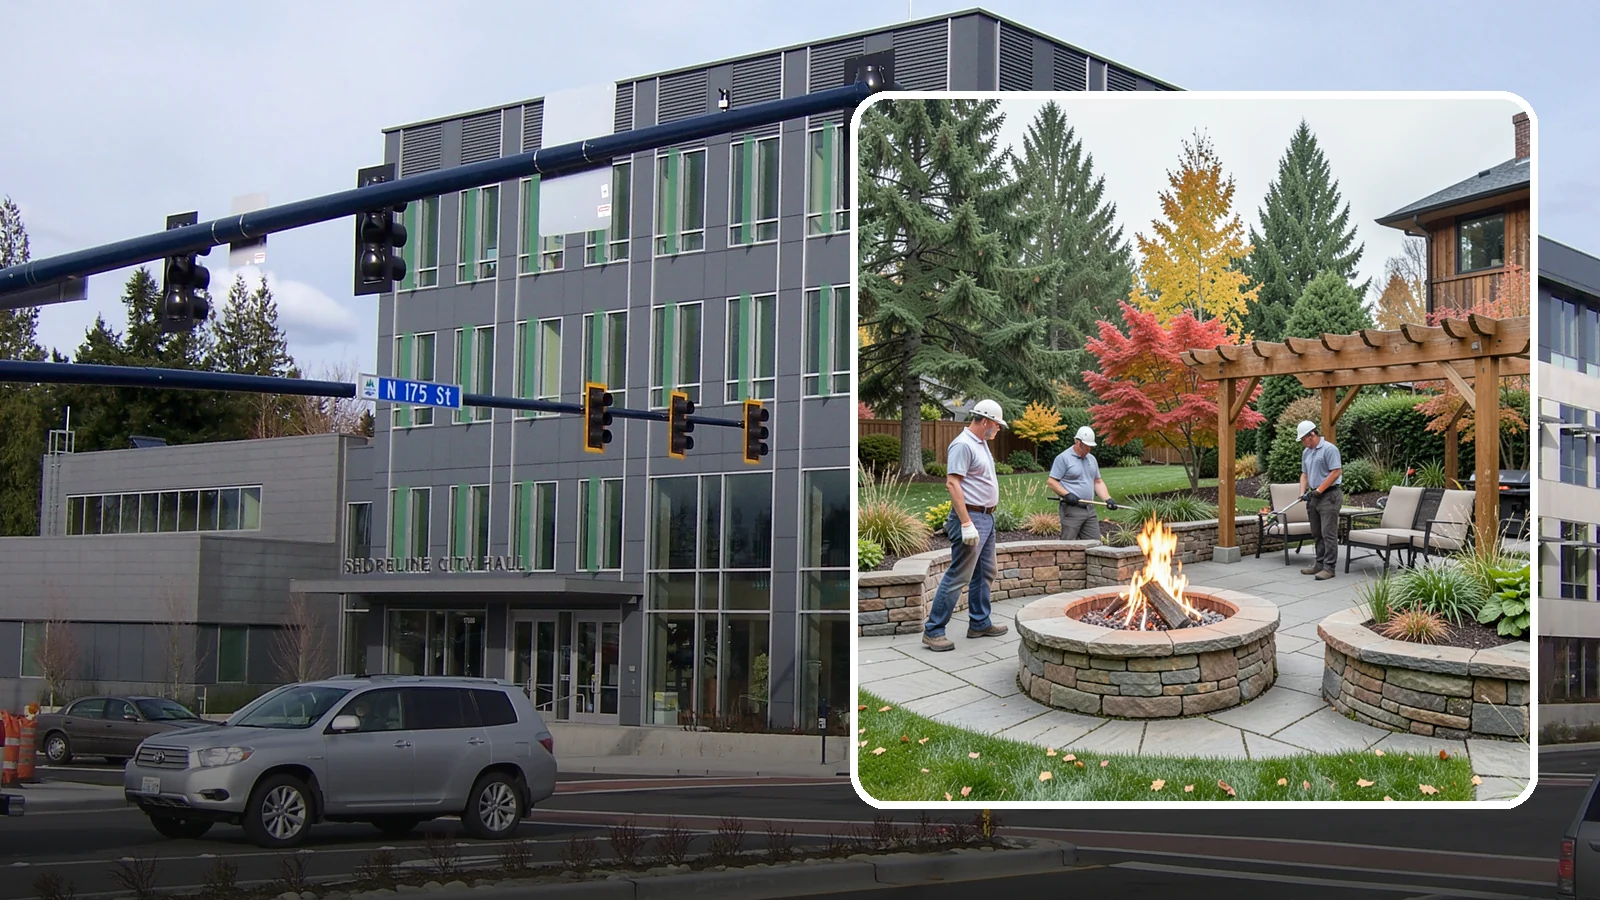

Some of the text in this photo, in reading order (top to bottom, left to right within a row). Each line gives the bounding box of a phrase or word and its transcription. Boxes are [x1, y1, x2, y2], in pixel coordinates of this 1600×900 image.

[387, 381, 452, 406] N 175 St
[344, 555, 526, 575] SHORELINE CITY HALL
